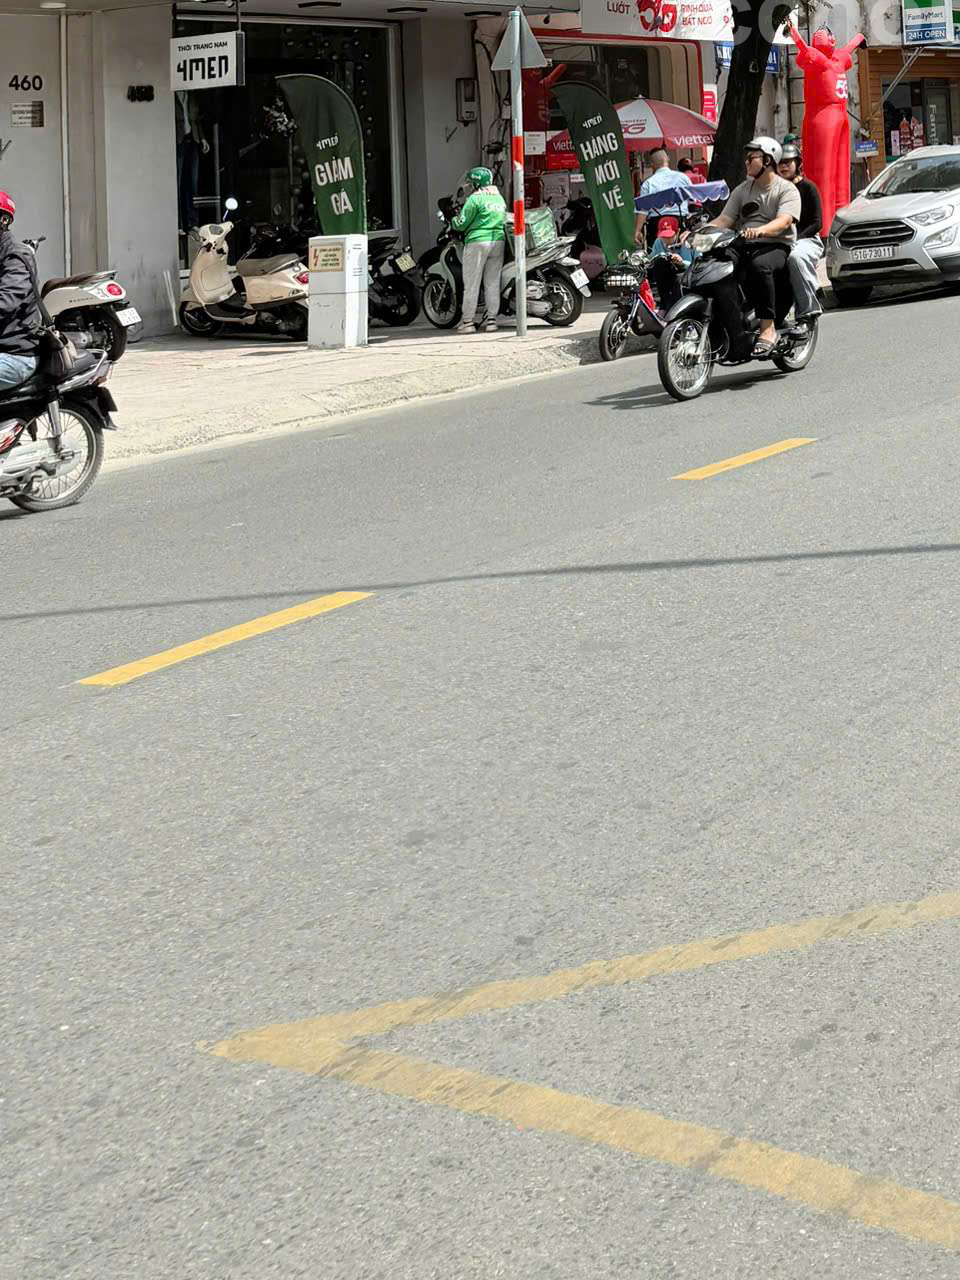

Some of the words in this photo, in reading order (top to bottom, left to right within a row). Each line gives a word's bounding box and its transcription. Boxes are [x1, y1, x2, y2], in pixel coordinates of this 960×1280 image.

[607, 1, 631, 15] LƯỚT
[908, 31, 923, 40] 24H
[924, 29, 945, 39] OPEN
[193, 41, 213, 51] TRANG
[214, 40, 228, 48] NAM
[176, 55, 229, 81] 4MEN
[9, 75, 43, 92] 460
[580, 131, 618, 161] HÀNG
